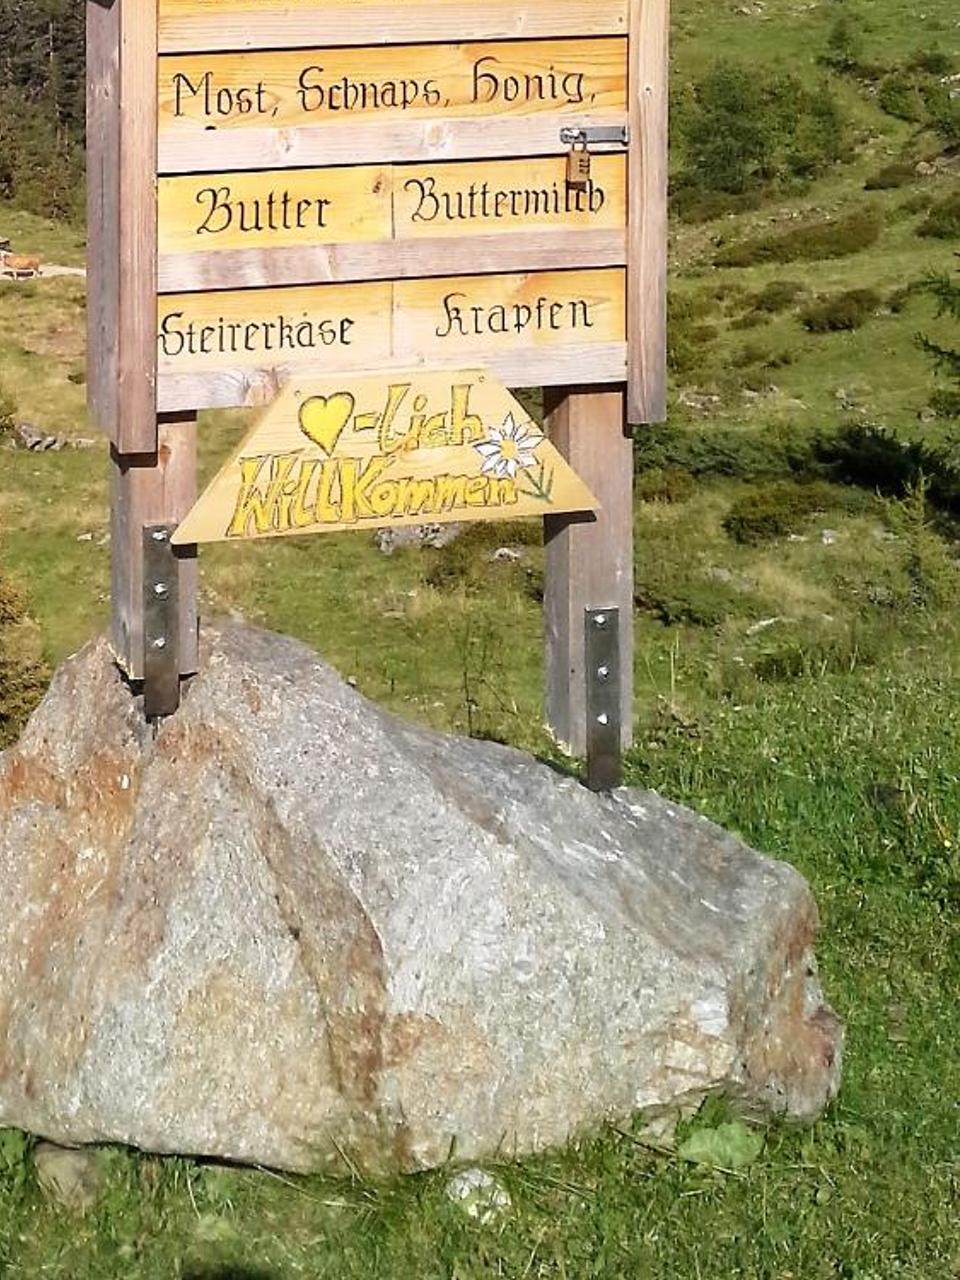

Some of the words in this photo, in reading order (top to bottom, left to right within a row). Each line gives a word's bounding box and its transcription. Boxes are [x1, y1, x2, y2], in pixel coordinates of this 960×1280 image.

[172, 71, 279, 117] Most,
[298, 66, 451, 111] Schnaps,
[195, 187, 331, 234] Butter
[403, 176, 605, 222] Buttermilch
[158, 311, 356, 356] Steirerkäse
[435, 292, 594, 337] Krapfen
